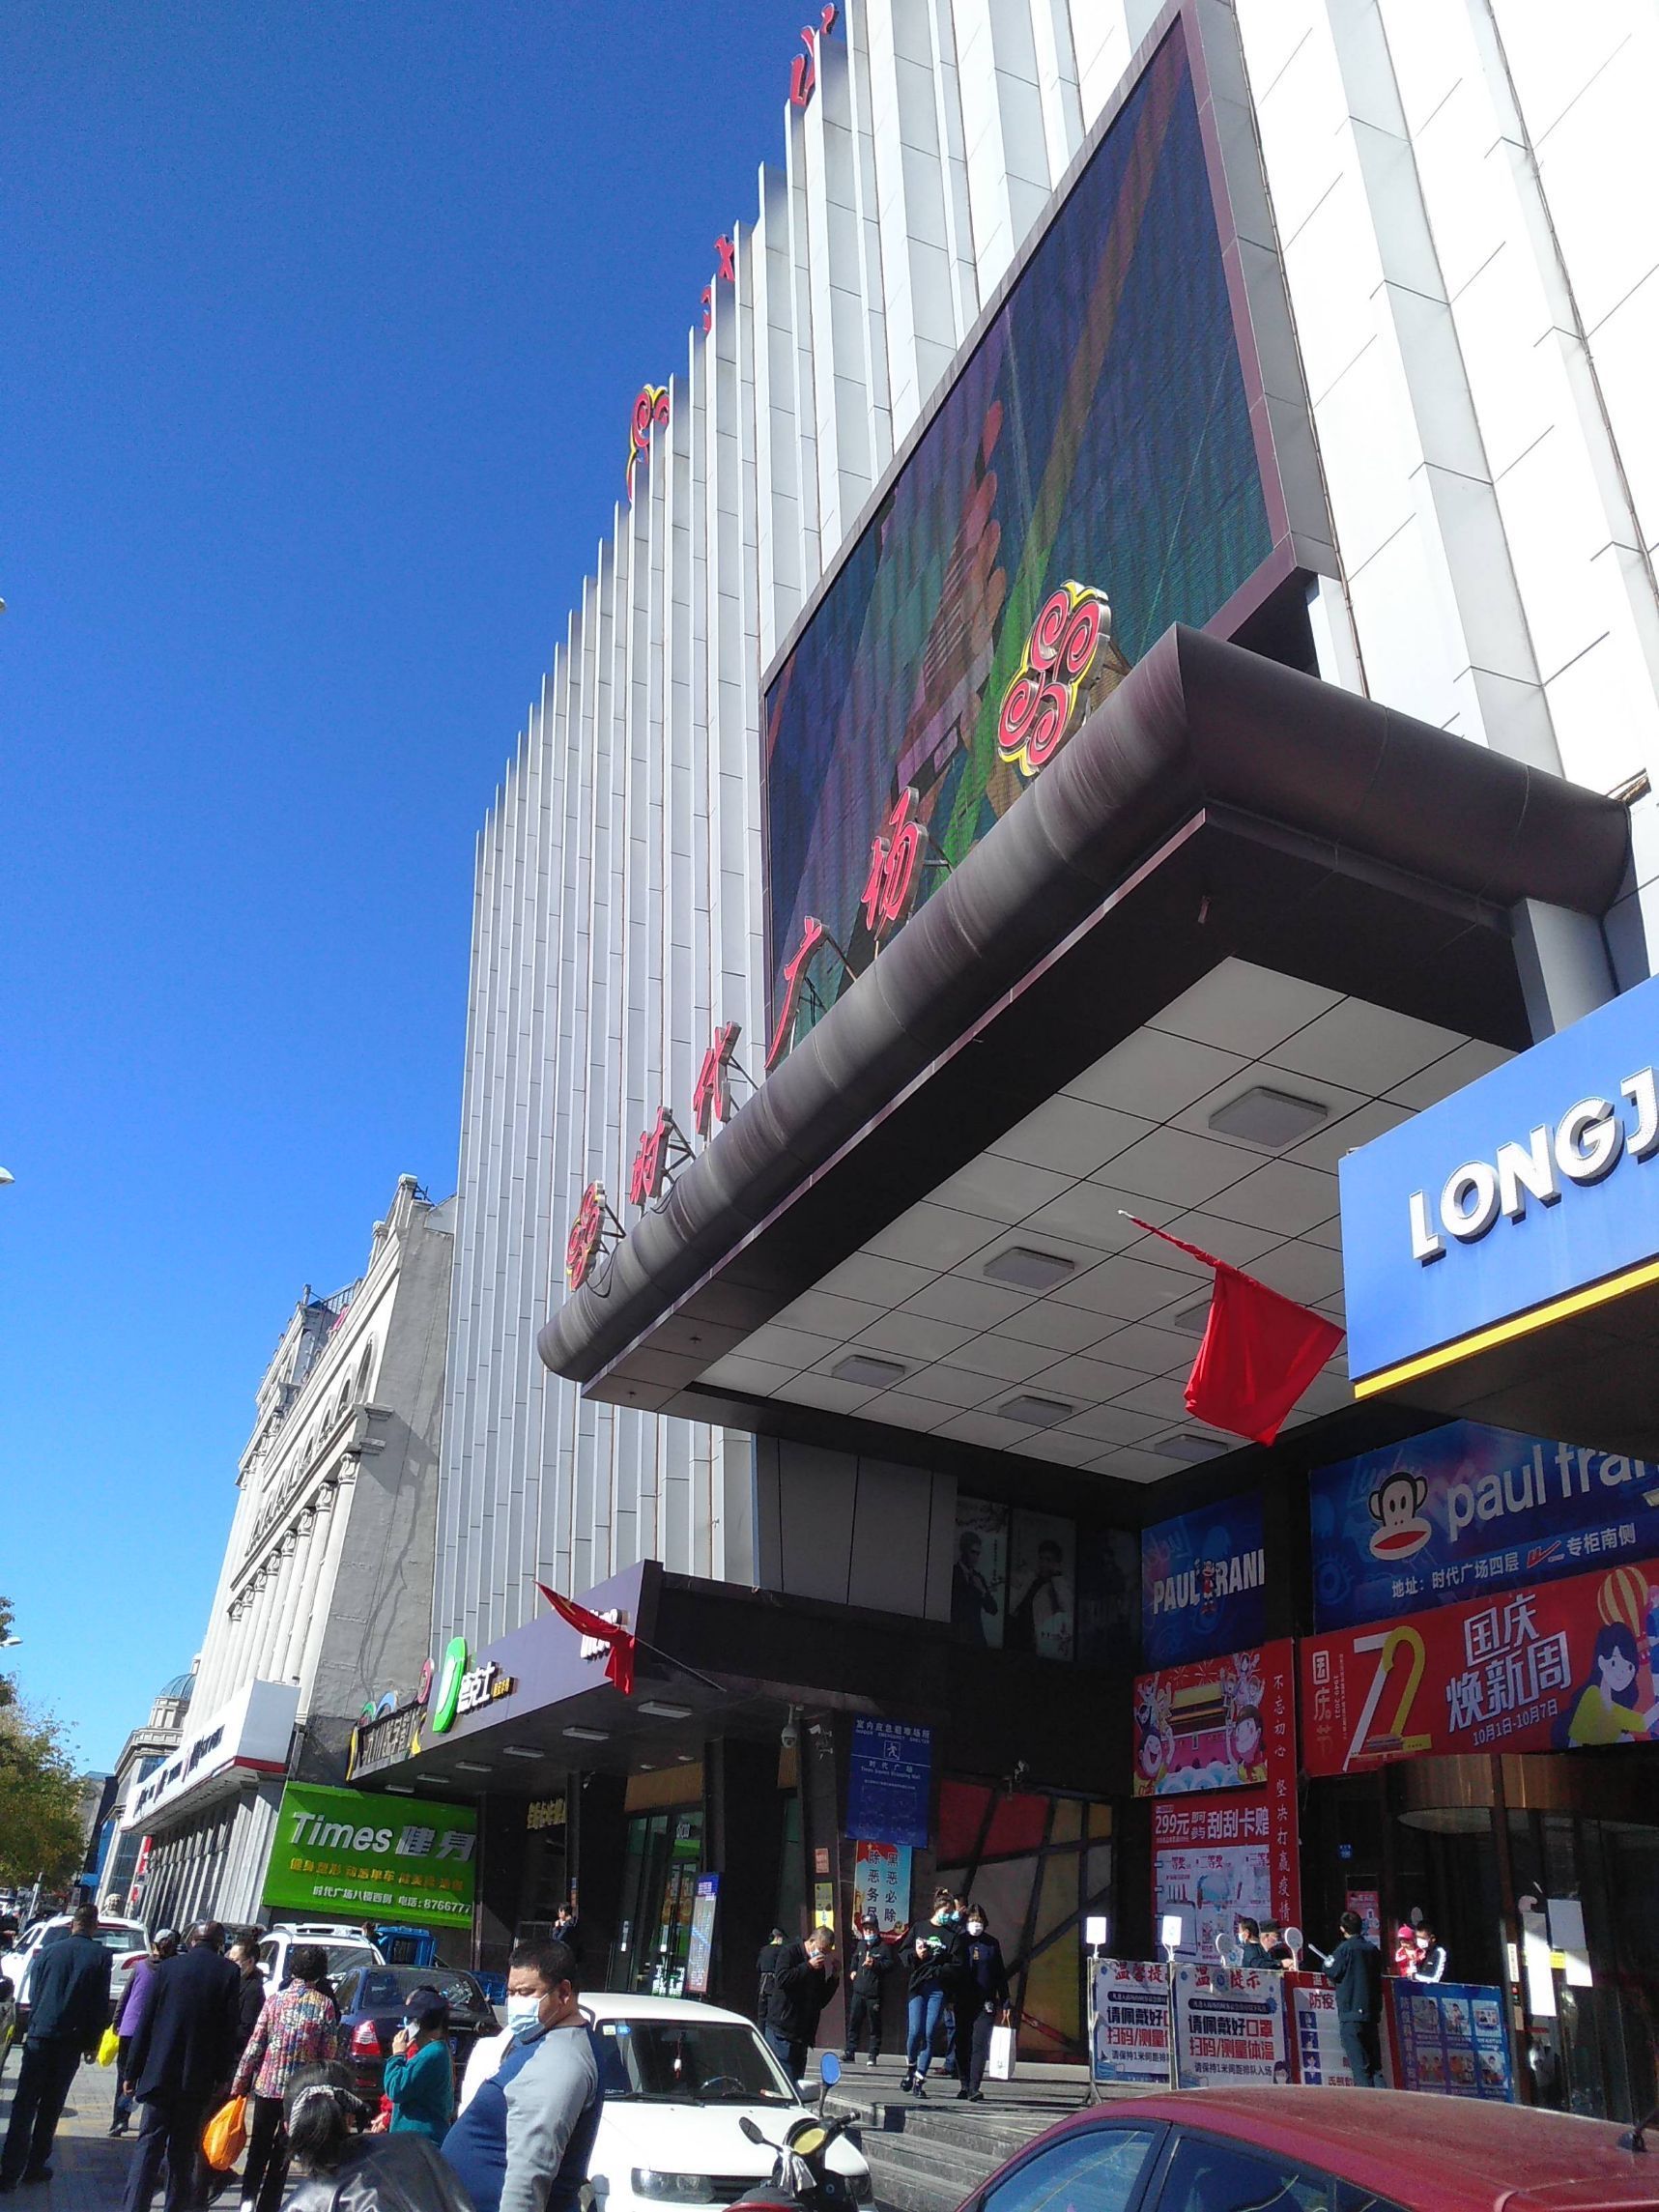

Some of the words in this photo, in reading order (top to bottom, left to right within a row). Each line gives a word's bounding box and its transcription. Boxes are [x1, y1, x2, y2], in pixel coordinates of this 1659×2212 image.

[1447, 1445, 1546, 1543] paul
[1555, 1442, 1659, 1499] fra
[1566, 1522, 1637, 1557] 专柜南侧
[1154, 1569, 1201, 1615] PAUL
[1464, 1594, 1541, 1668] 国庆
[1445, 1630, 1572, 1733] 焕新周
[290, 1811, 393, 1853] Times
[394, 1824, 477, 1862] 健身
[1155, 1812, 1189, 1835] 299元
[884, 1852, 900, 1922] 黑恶必除
[1115, 1961, 1169, 1984] 温馨提
[1194, 1966, 1261, 1991] 温提示
[1107, 2006, 1168, 2026] 请佩戴好
[1188, 2014, 1274, 2038] 请佩戴好口罩
[1107, 2028, 1169, 2049] 扫码/测量
